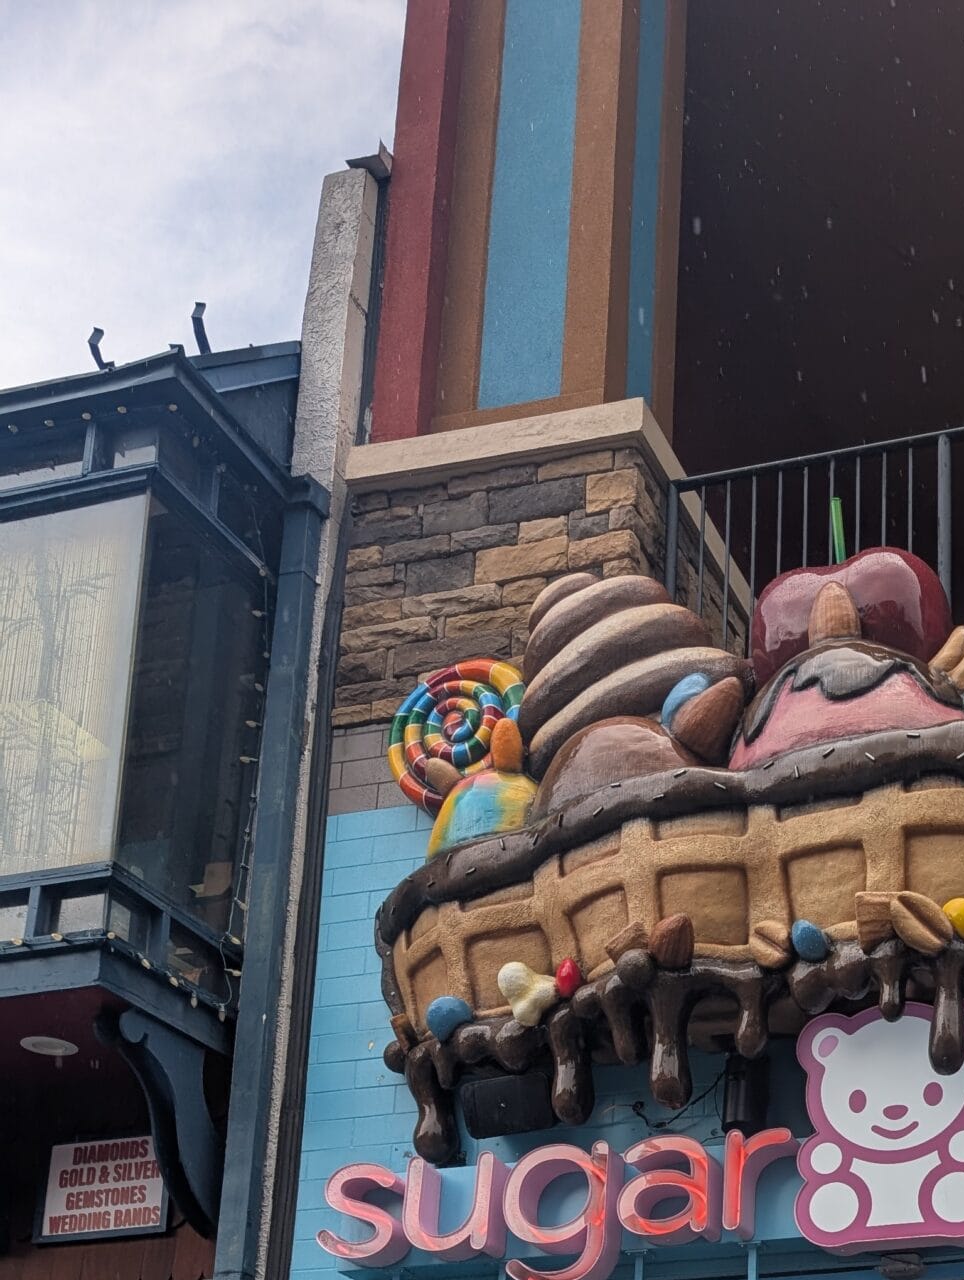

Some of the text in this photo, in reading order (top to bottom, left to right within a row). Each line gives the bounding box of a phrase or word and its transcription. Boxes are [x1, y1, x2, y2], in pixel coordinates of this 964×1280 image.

[72, 1139, 150, 1166] DIAMONDS
[58, 1159, 161, 1188] GOLD & SILVER
[65, 1185, 147, 1211] GEMSTONES
[48, 1206, 161, 1234] WEDDING BANDS
